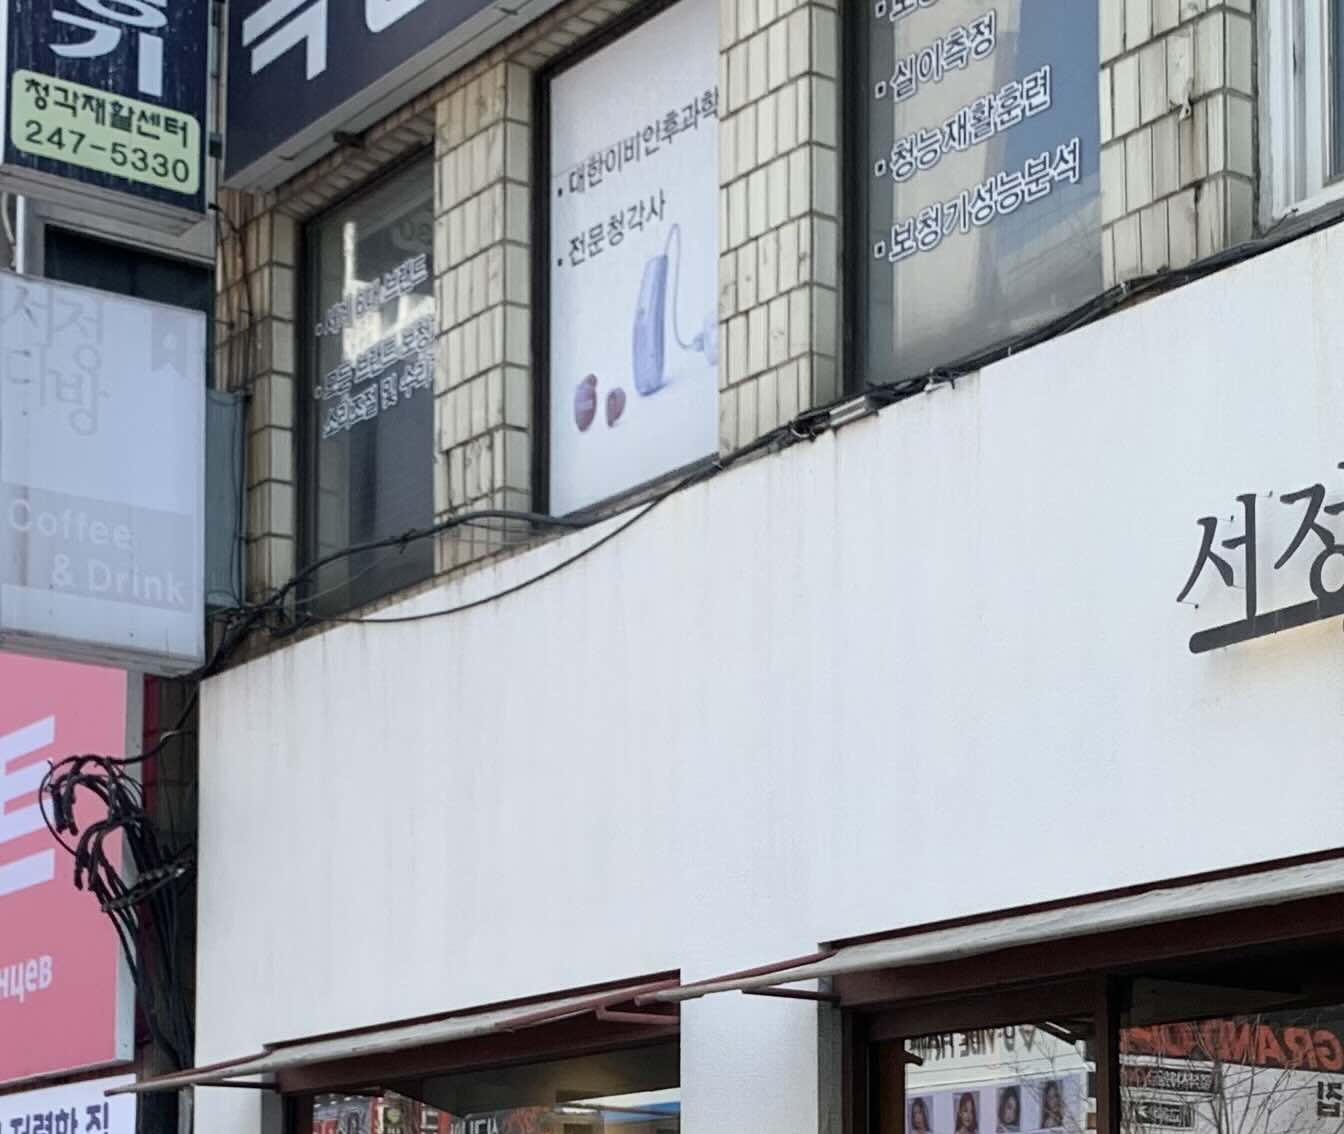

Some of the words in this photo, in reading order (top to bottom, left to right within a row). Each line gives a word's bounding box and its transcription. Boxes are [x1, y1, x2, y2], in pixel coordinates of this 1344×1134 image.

[889, 8, 997, 103] 실이측정
[25, 78, 189, 148] 청각재활센터
[889, 64, 1052, 183] 청능재활훈련
[24, 120, 190, 184] 247-5330
[567, 188, 667, 268] 전문청각사
[888, 136, 1081, 262] 보청기성능분석
[6, 498, 134, 552] Coffee
[88, 558, 186, 607] Drink
